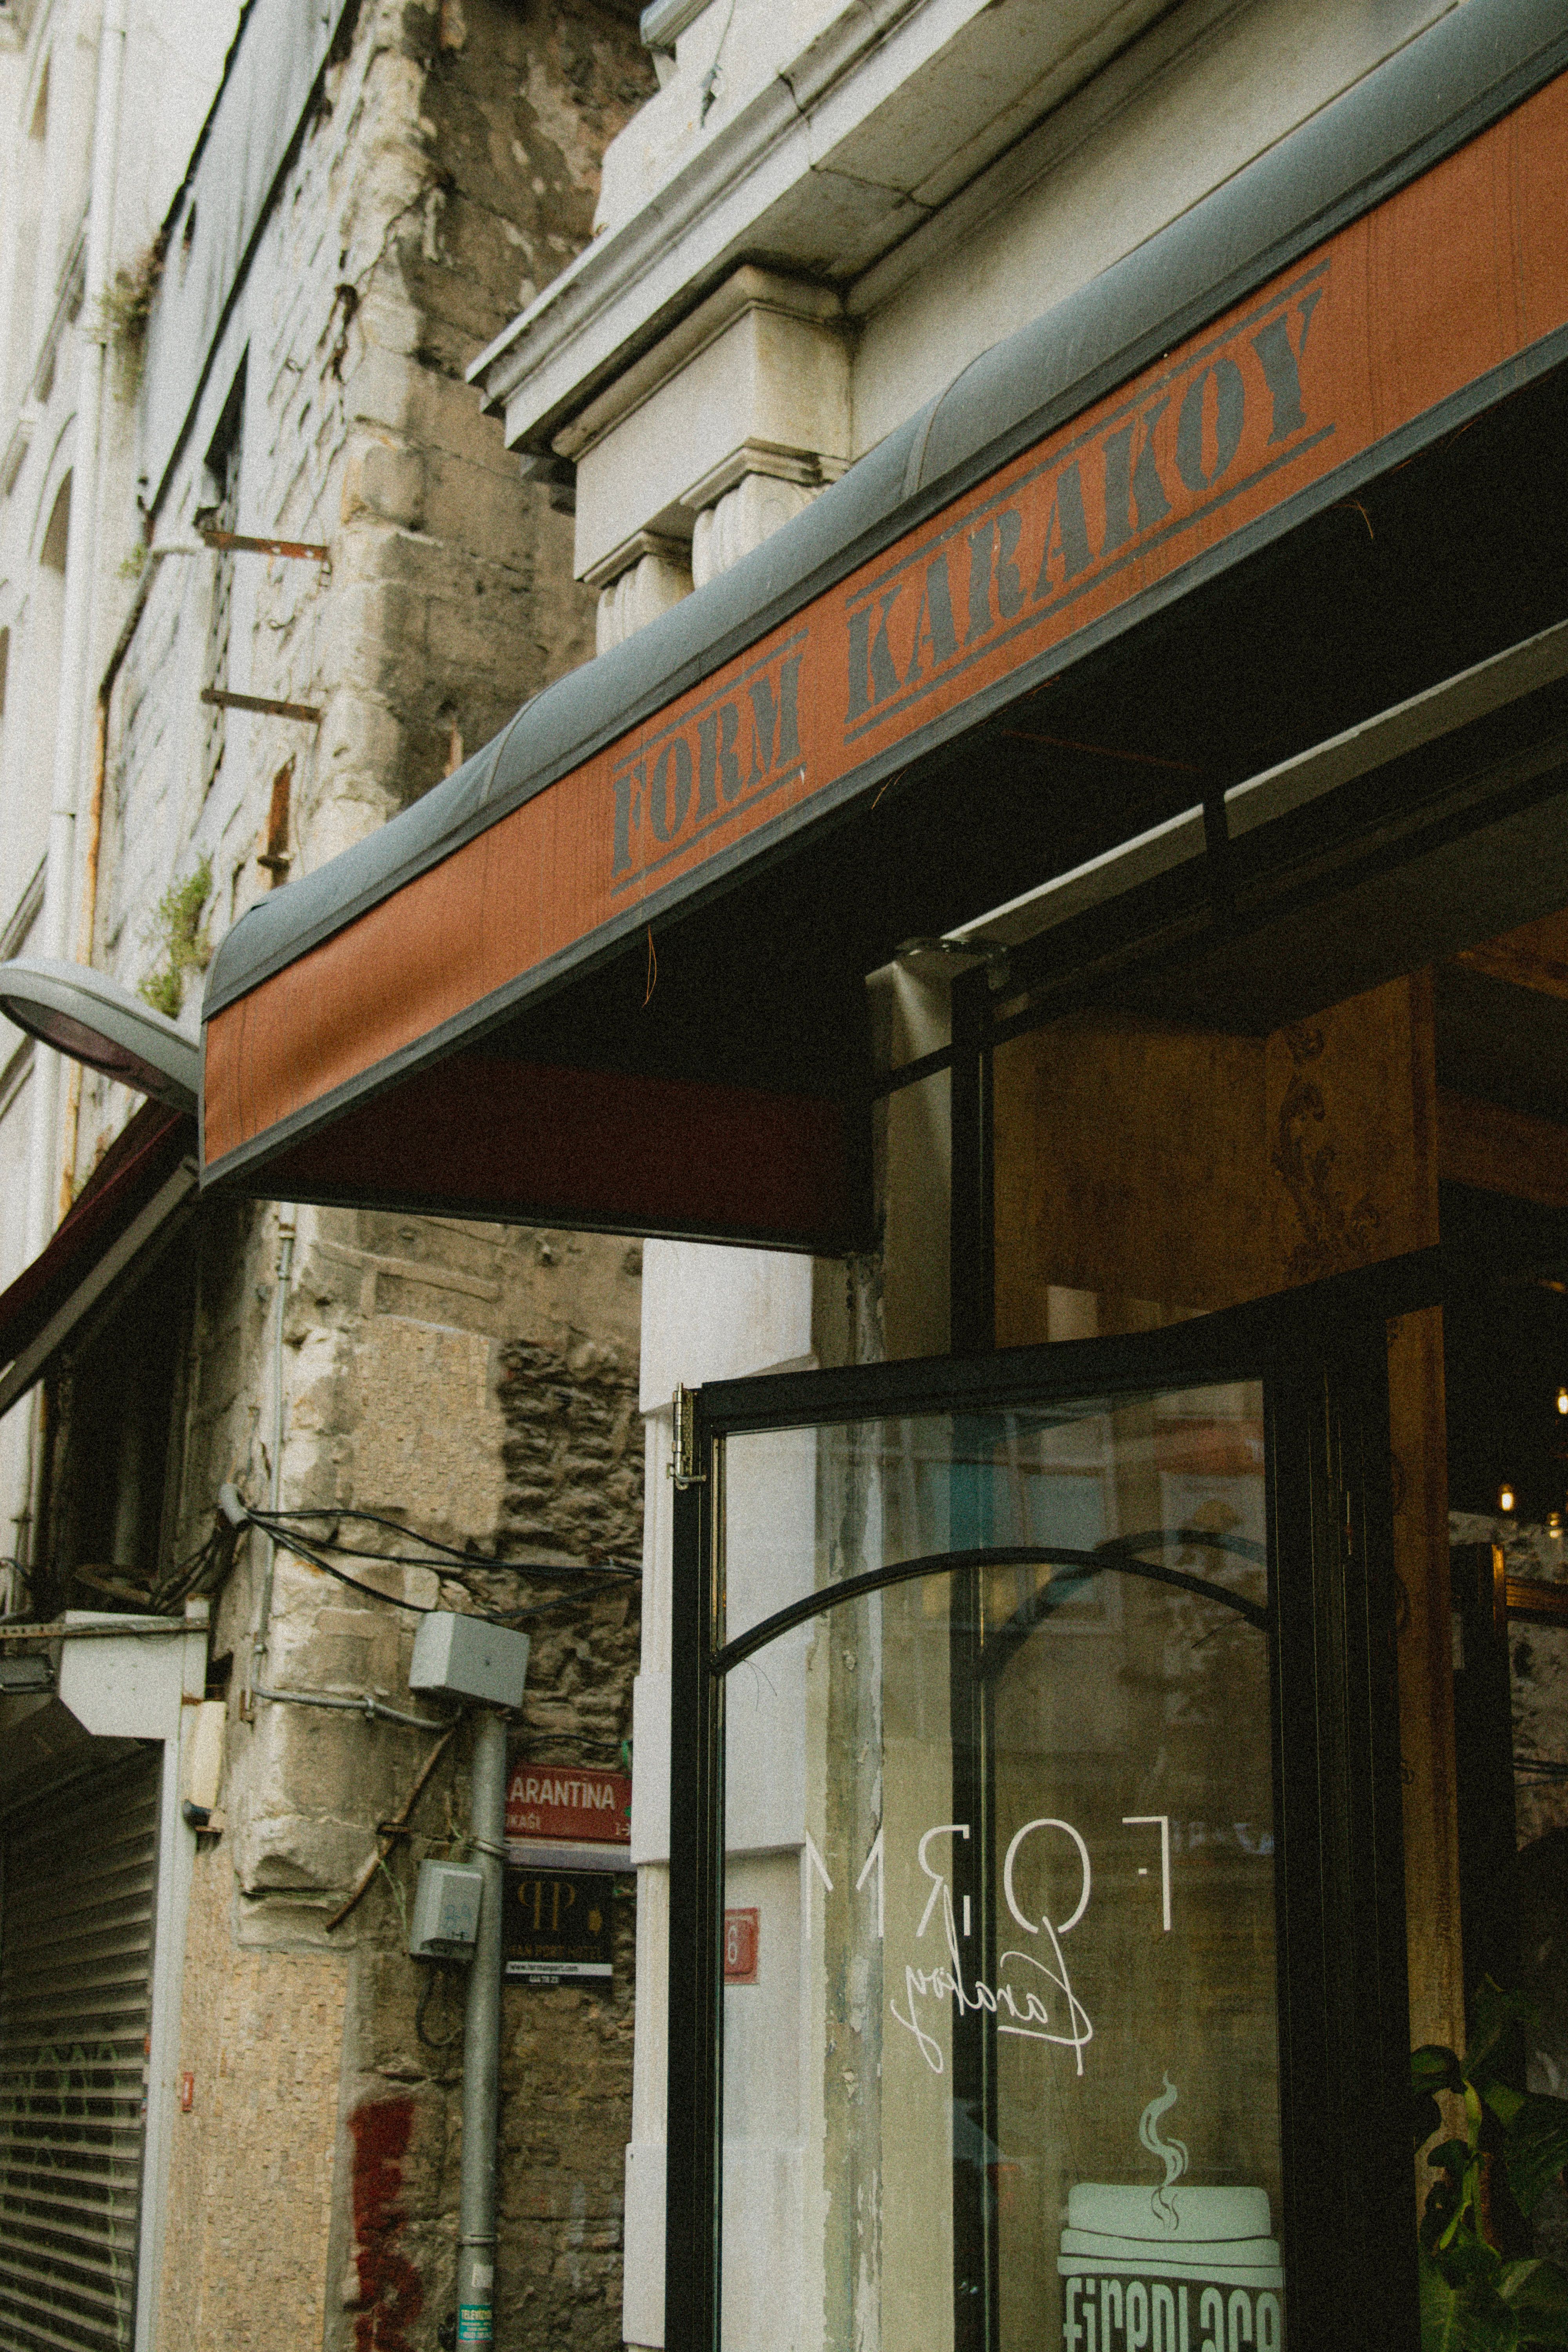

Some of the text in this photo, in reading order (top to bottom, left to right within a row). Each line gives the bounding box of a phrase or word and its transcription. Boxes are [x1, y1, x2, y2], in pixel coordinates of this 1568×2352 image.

[612, 299, 1322, 879] FORM KARAKOY
[509, 1777, 615, 1809] ARANTİNA
[506, 1813, 541, 1830] KAĞI
